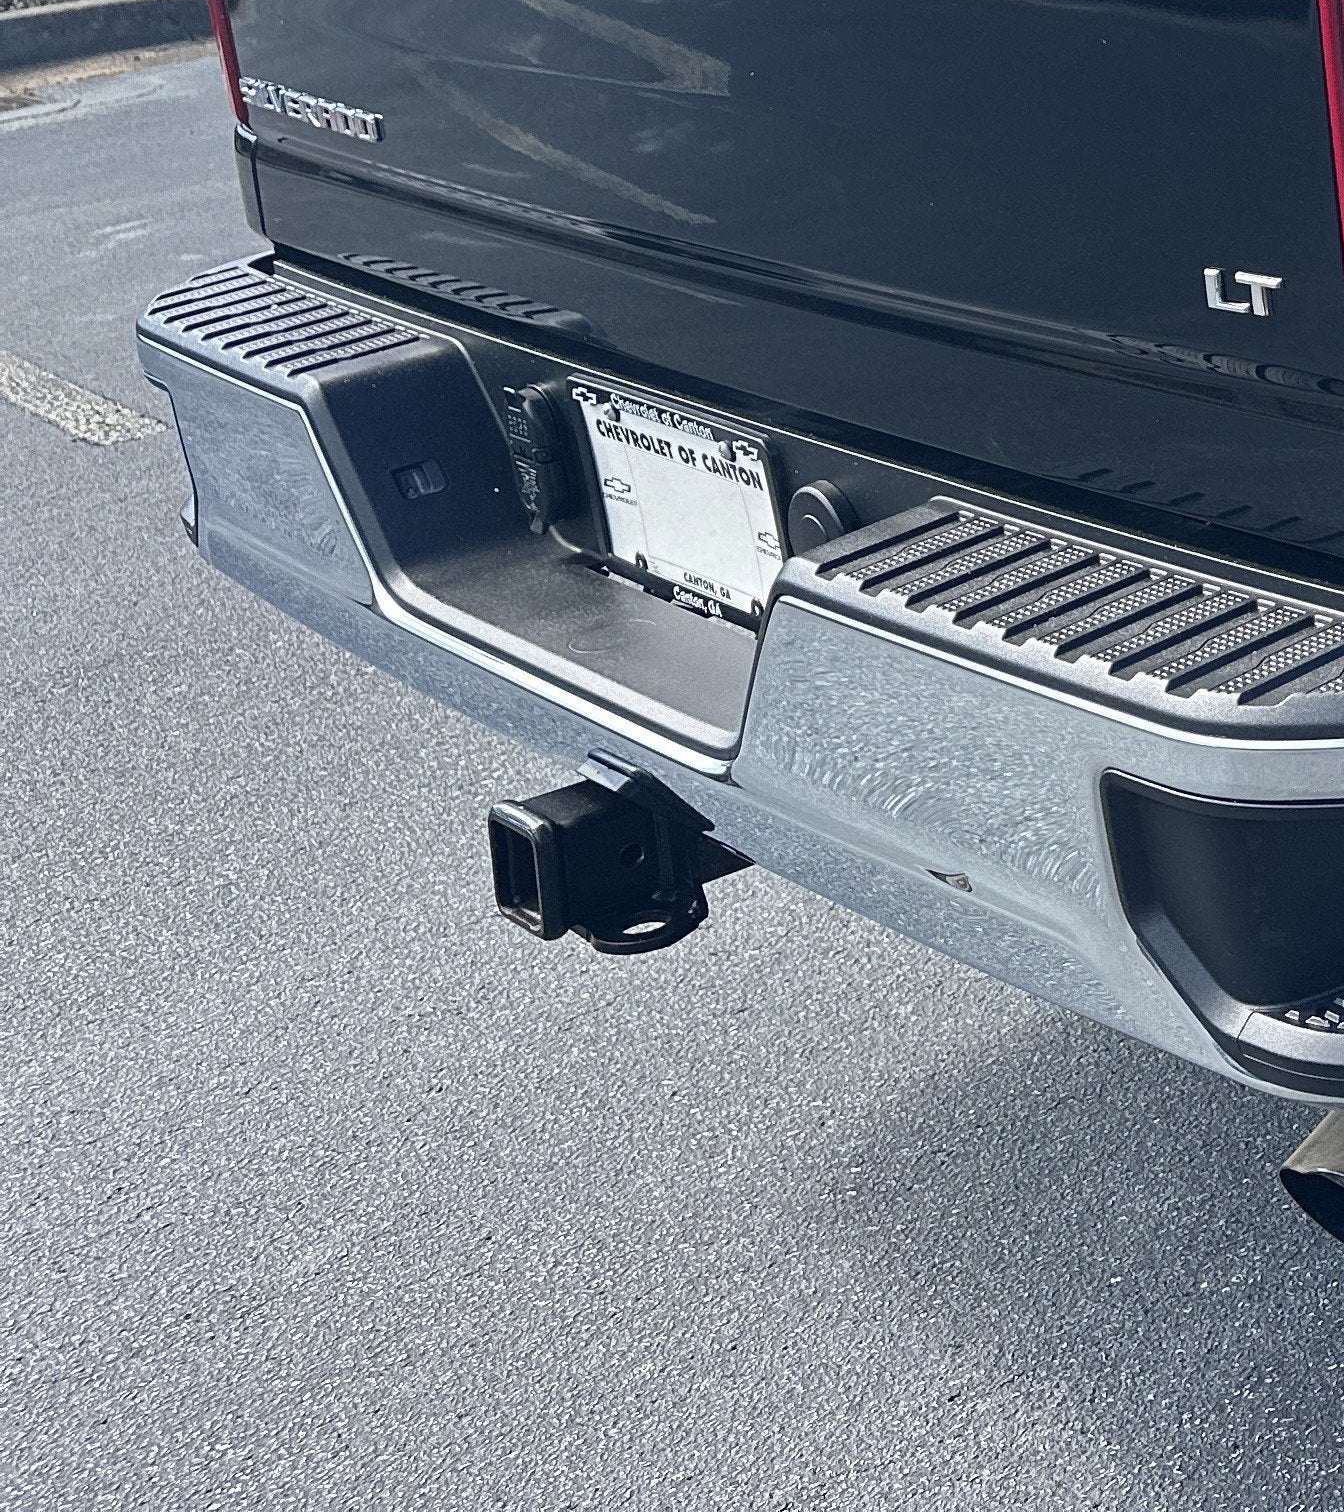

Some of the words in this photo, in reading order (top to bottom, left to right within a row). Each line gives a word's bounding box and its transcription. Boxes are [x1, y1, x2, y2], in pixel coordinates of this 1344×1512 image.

[239, 77, 384, 143] SILVERADO
[1203, 267, 1282, 317] LT
[610, 392, 660, 423] Chevrolet
[661, 411, 674, 427] of
[673, 413, 715, 441] Canton
[596, 418, 675, 461] CHEVROLET
[678, 445, 698, 469] OF
[701, 453, 764, 492] CANTON
[683, 572, 718, 595] CANTON,
[720, 586, 732, 600] GA
[707, 599, 723, 617] GA
